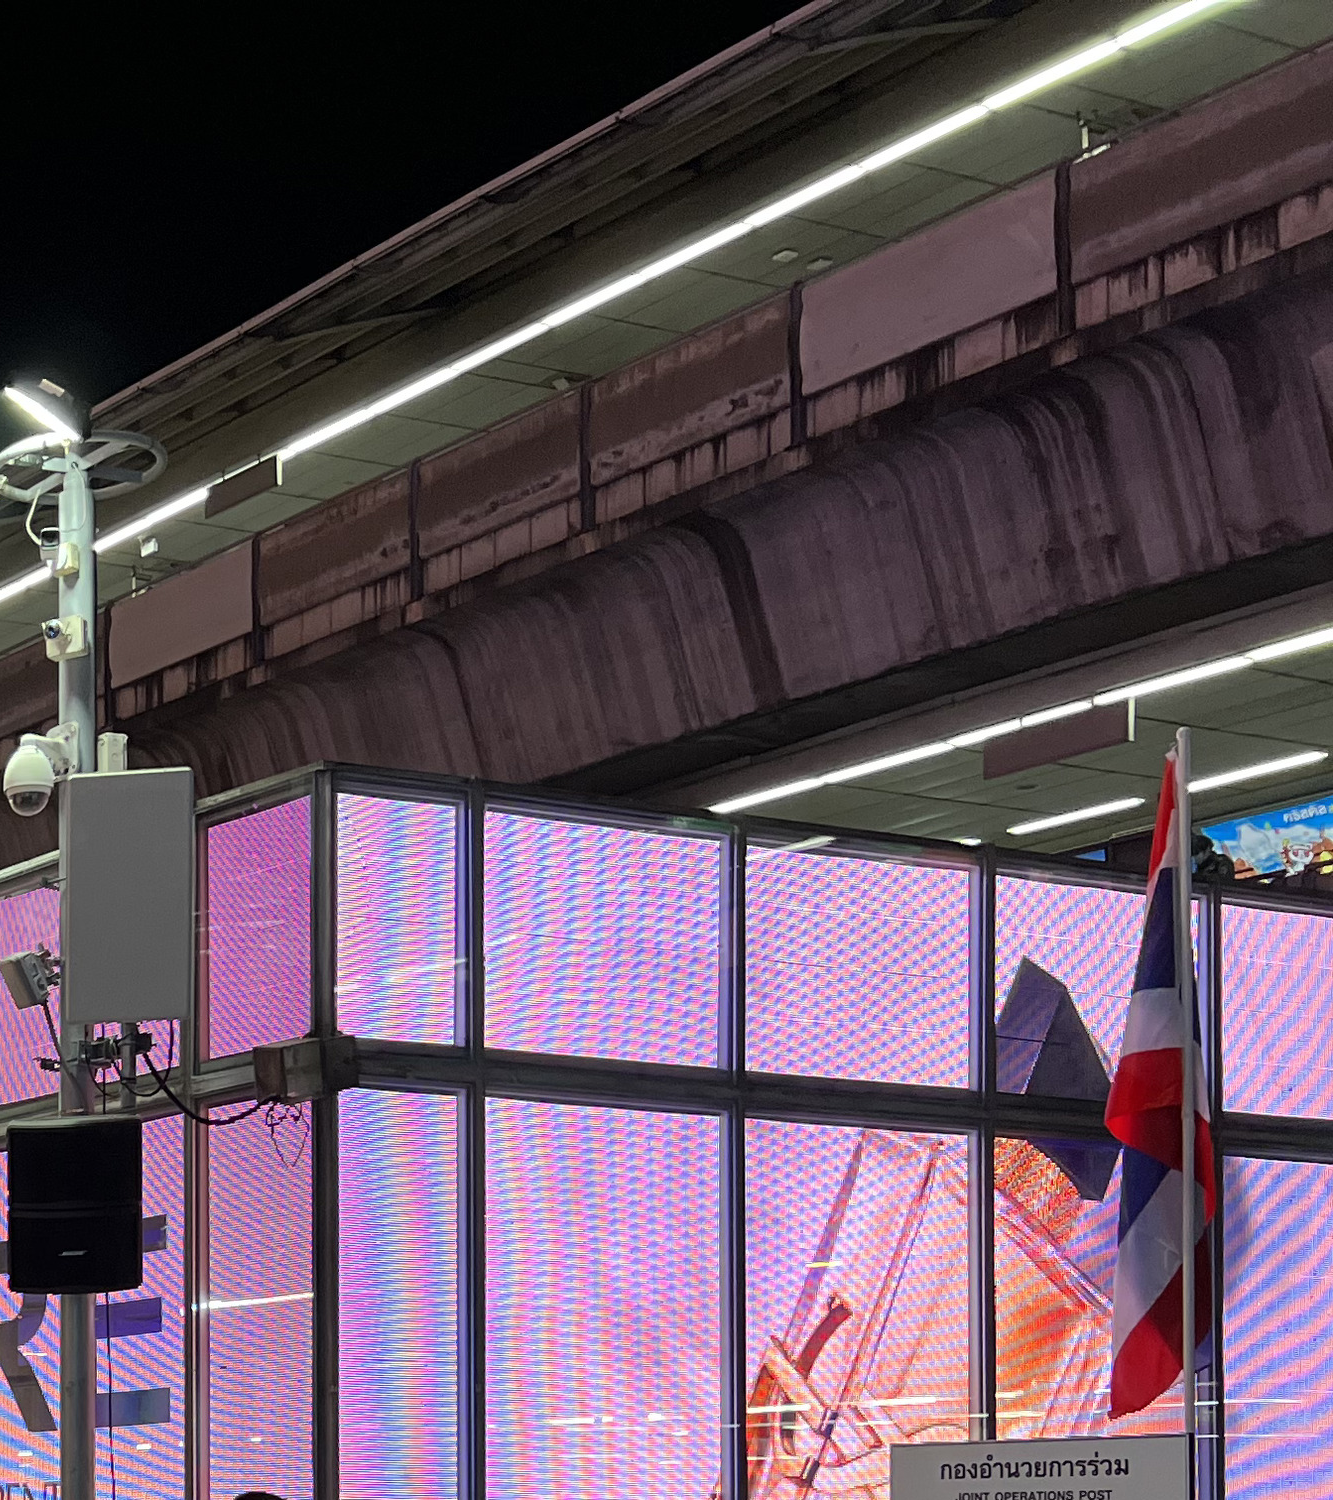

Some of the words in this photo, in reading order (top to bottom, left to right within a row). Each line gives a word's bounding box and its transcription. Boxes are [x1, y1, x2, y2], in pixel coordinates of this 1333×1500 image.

[940, 1451, 1130, 1480] กองอำนวยการร่วม
[1079, 1489, 1113, 1500] POST
